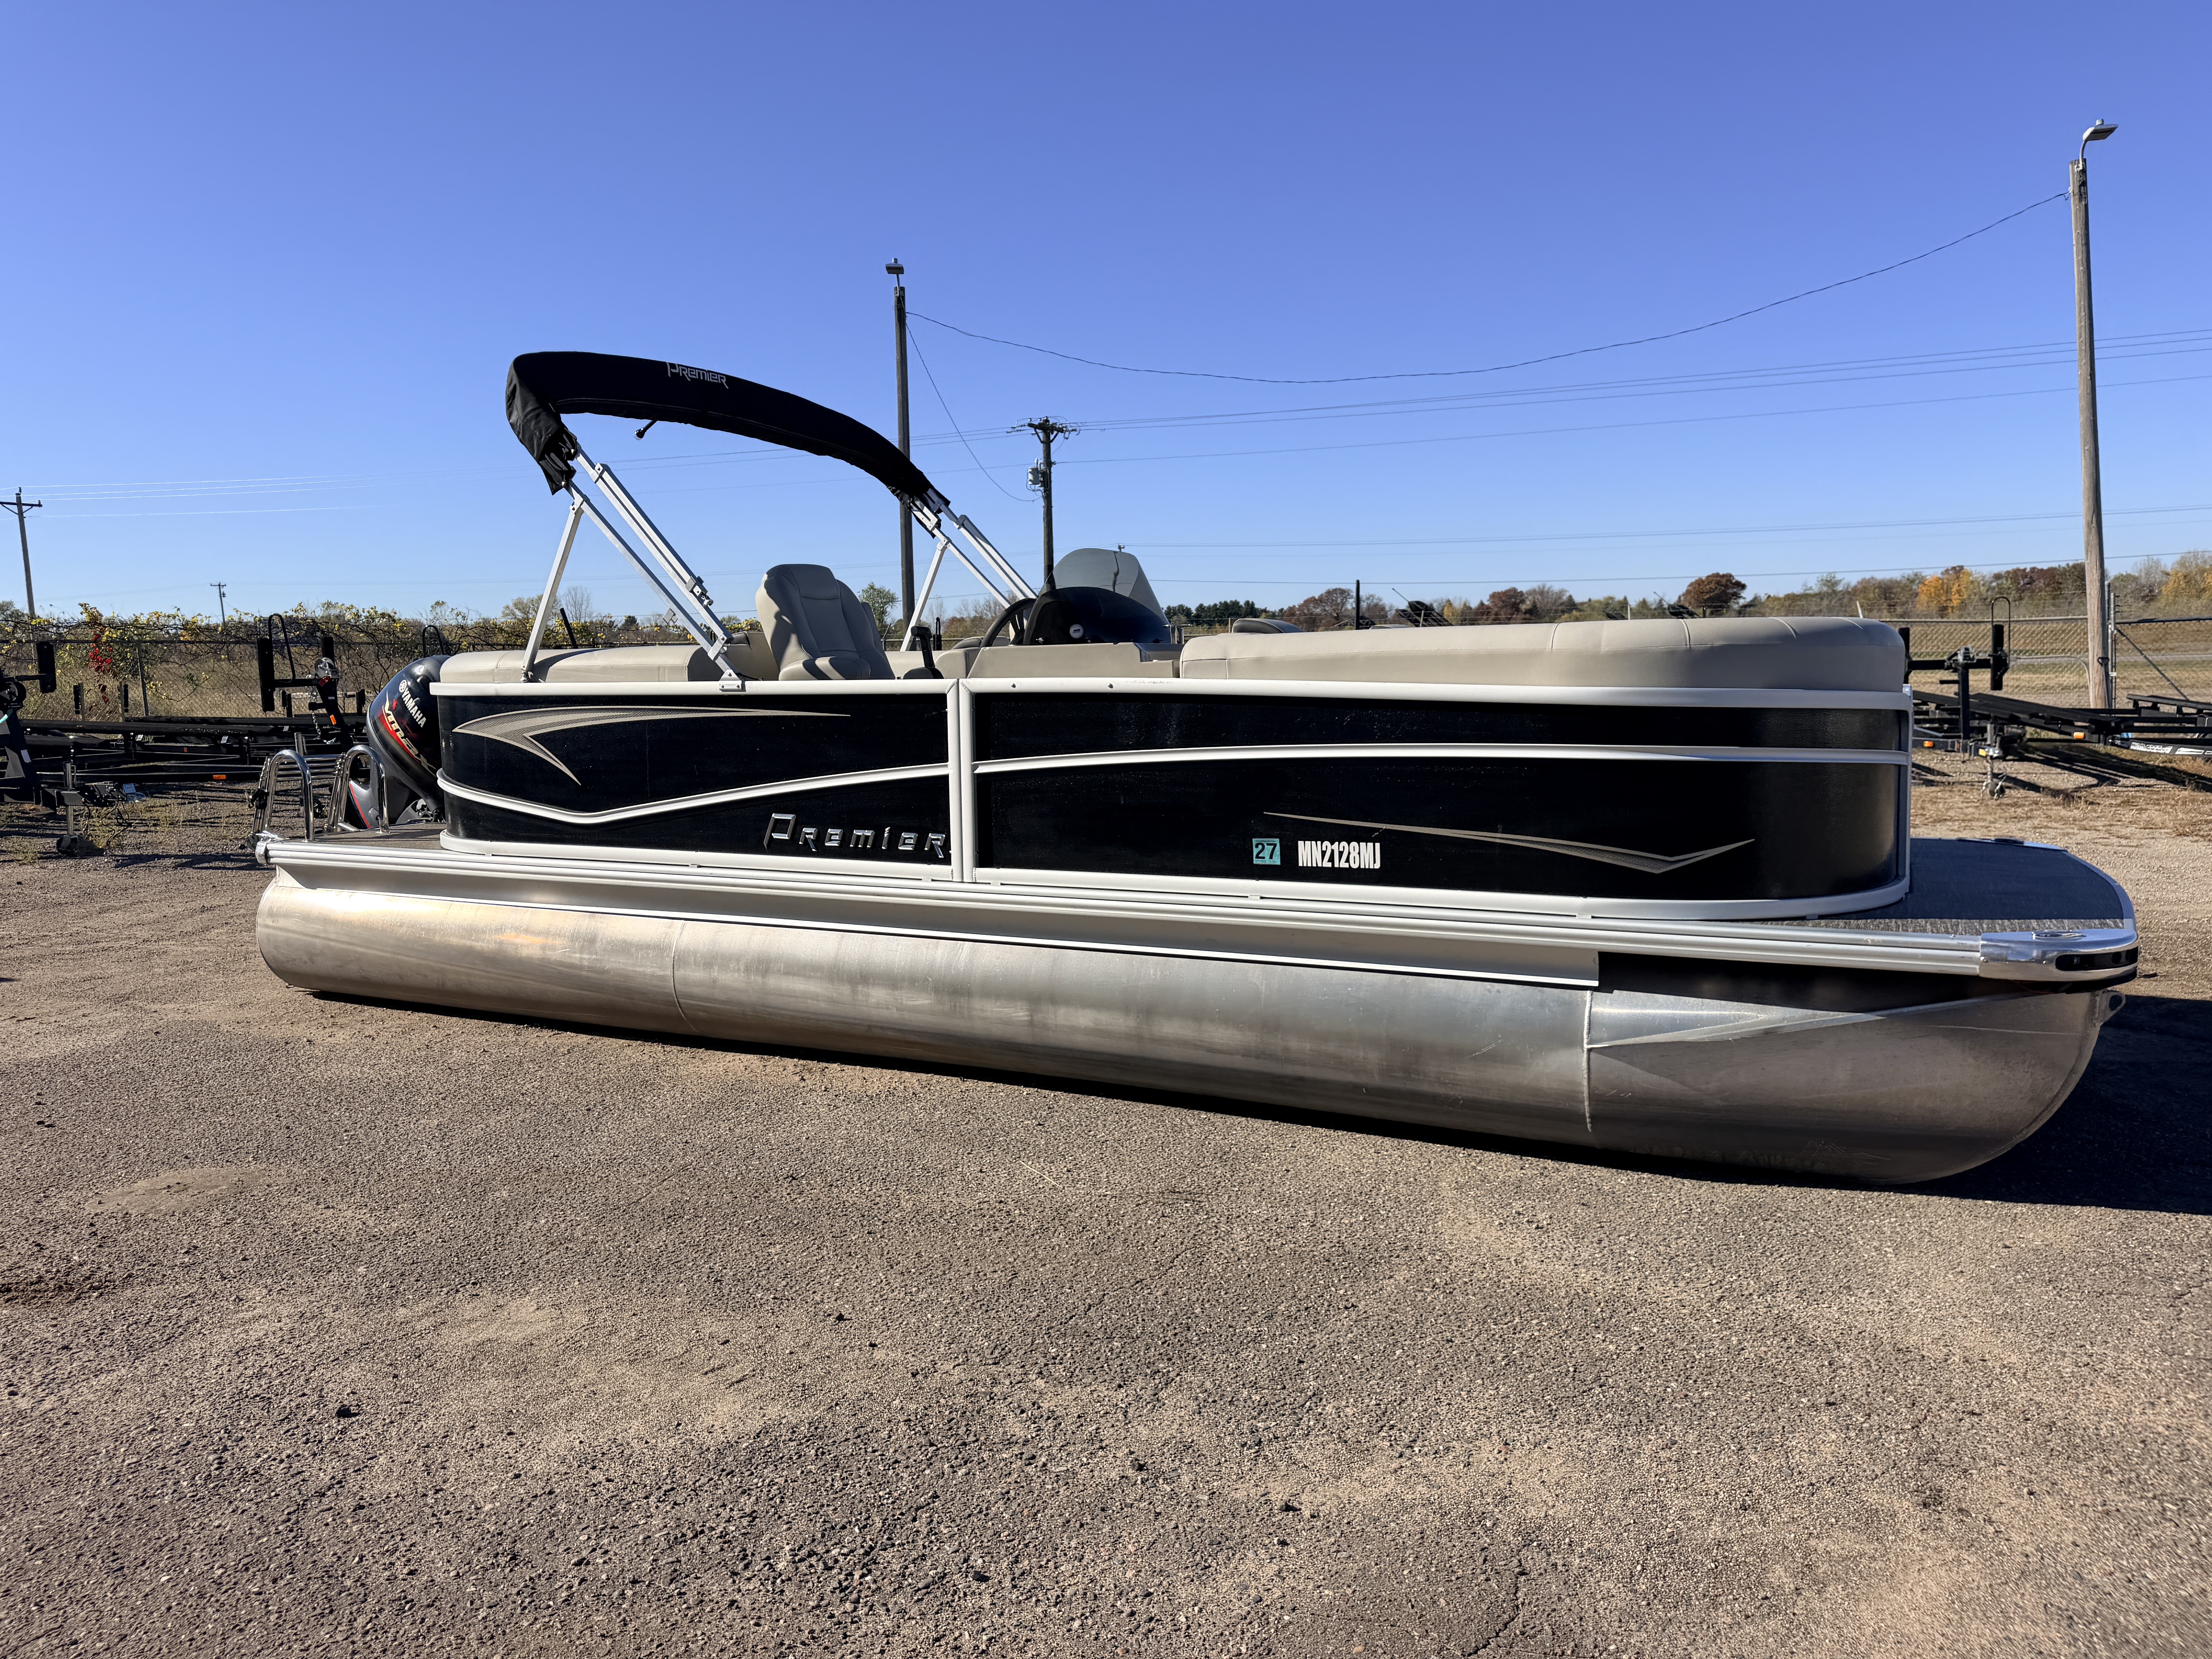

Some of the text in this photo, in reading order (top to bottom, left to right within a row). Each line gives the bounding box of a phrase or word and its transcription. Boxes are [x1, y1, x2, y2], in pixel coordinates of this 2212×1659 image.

[402, 687, 426, 728] YAMAHA
[1255, 842, 1277, 859] 27
[1298, 840, 1381, 869] MN2128MJ
